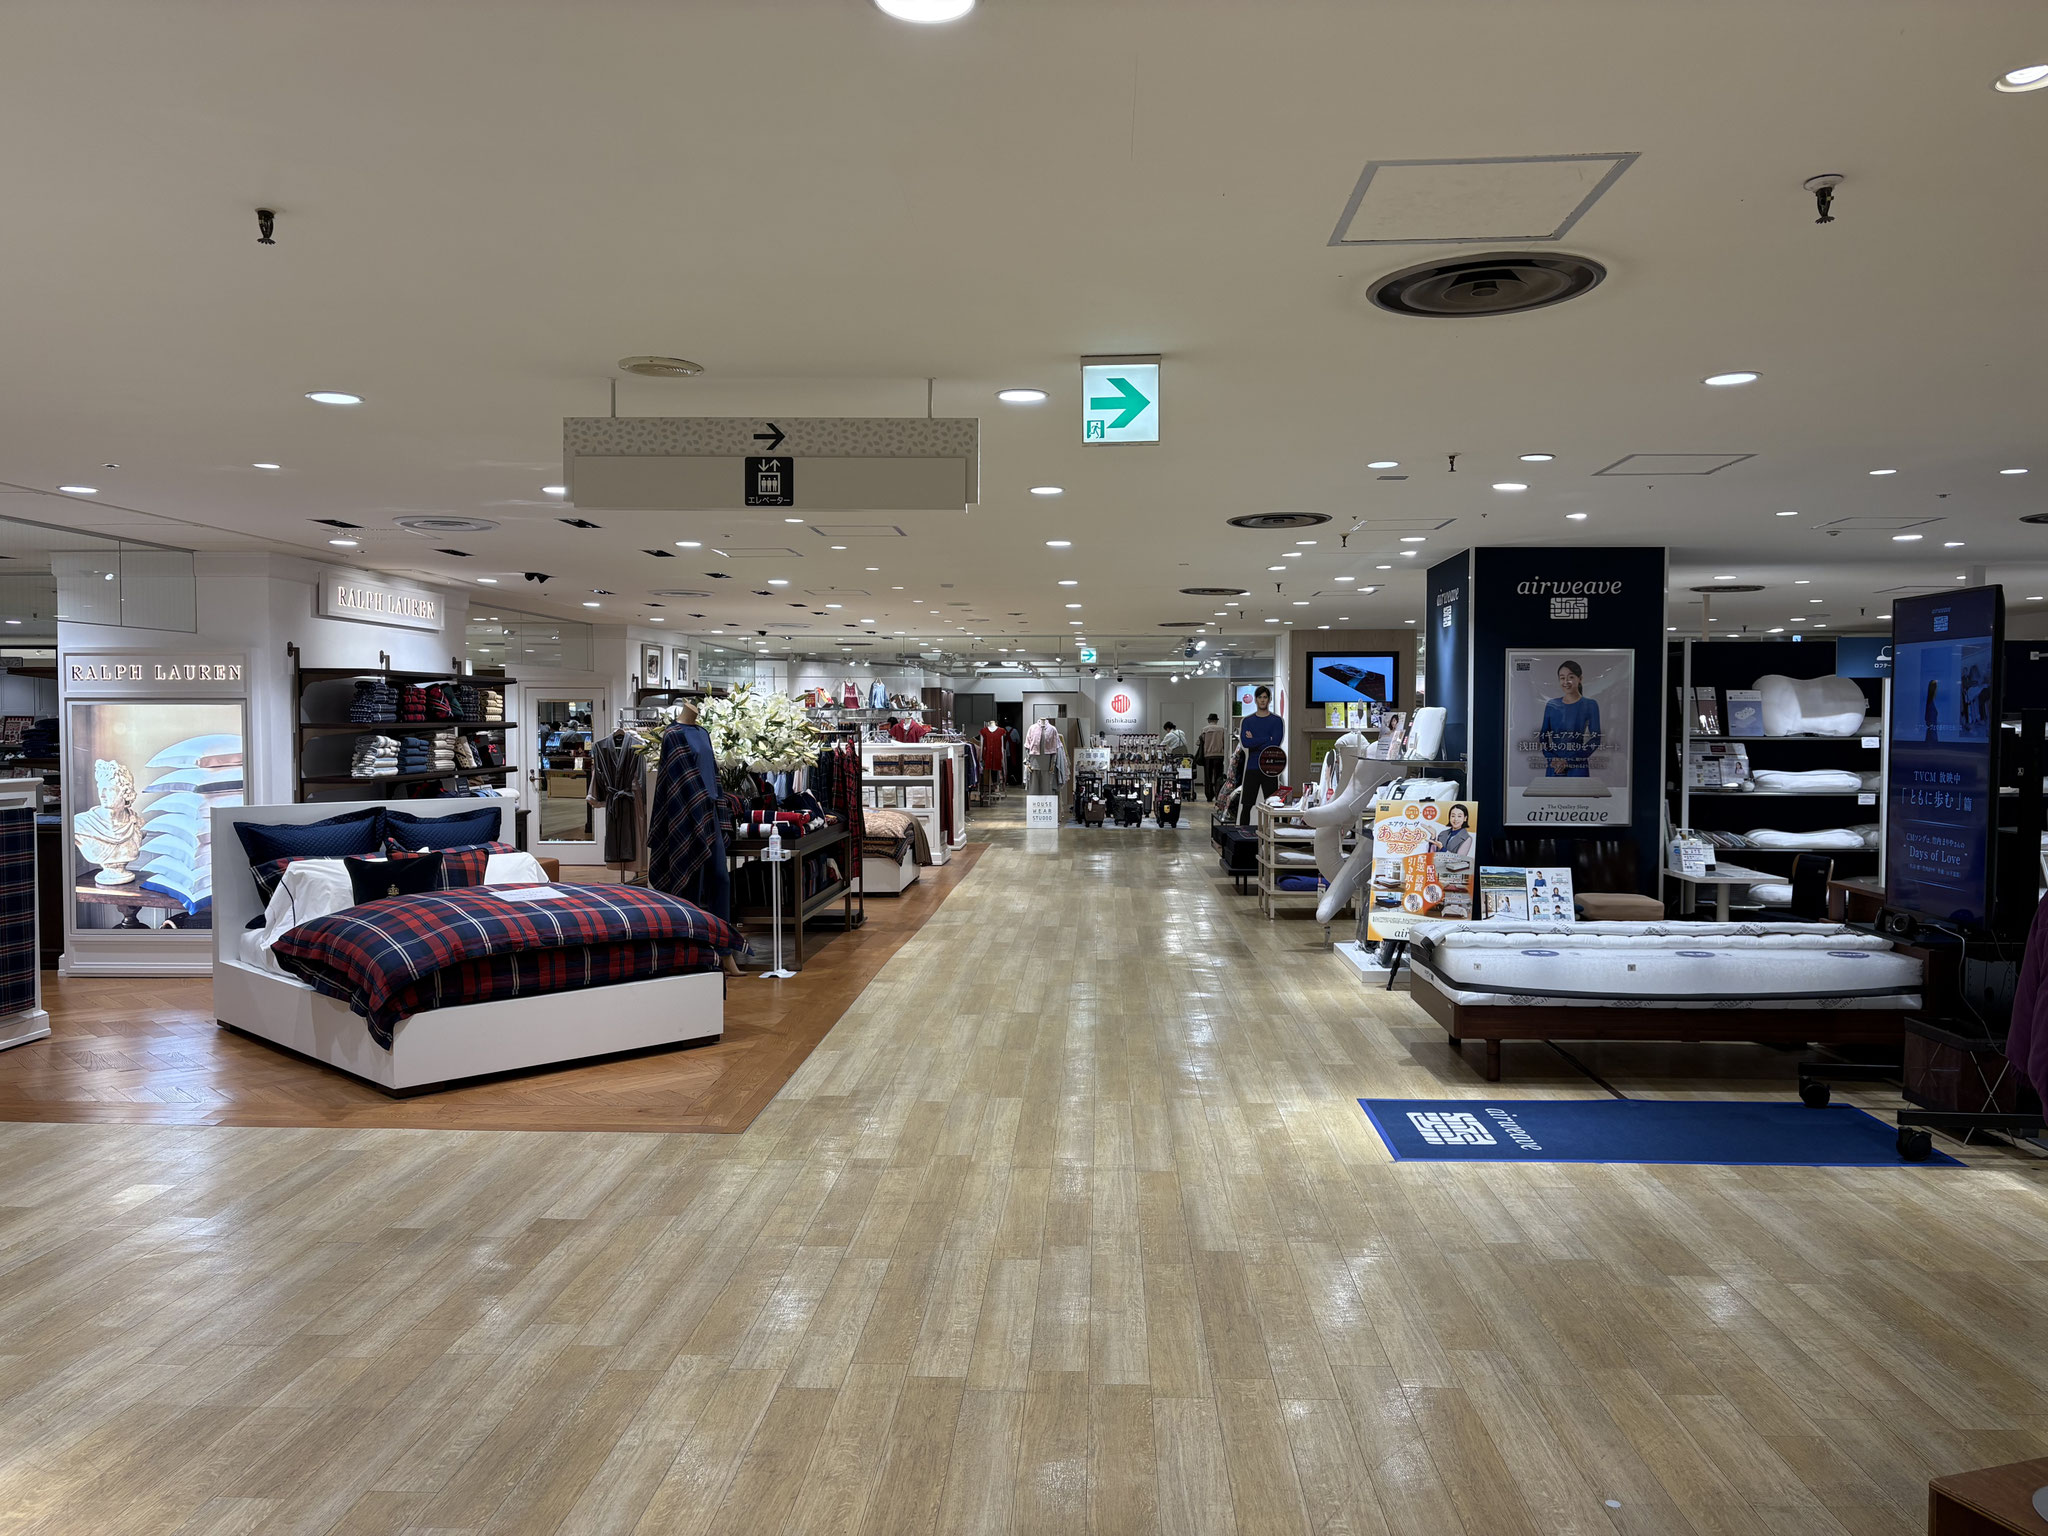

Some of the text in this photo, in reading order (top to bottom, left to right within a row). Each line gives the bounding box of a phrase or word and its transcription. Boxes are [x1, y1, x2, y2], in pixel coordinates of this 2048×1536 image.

[748, 496, 791, 505] エレベーター
[1517, 575, 1622, 595] airweave
[337, 586, 435, 620] RALPH LAUREN
[71, 664, 243, 682] RALPH LAUREN
[1533, 731, 1606, 740] フィギュアスケーター
[1913, 771, 1936, 782] TVCM
[1527, 807, 1609, 822] airweave
[1909, 845, 1961, 865] Days of Love
[1426, 865, 1436, 882] 配送
[1485, 1107, 1543, 1151] airweave
